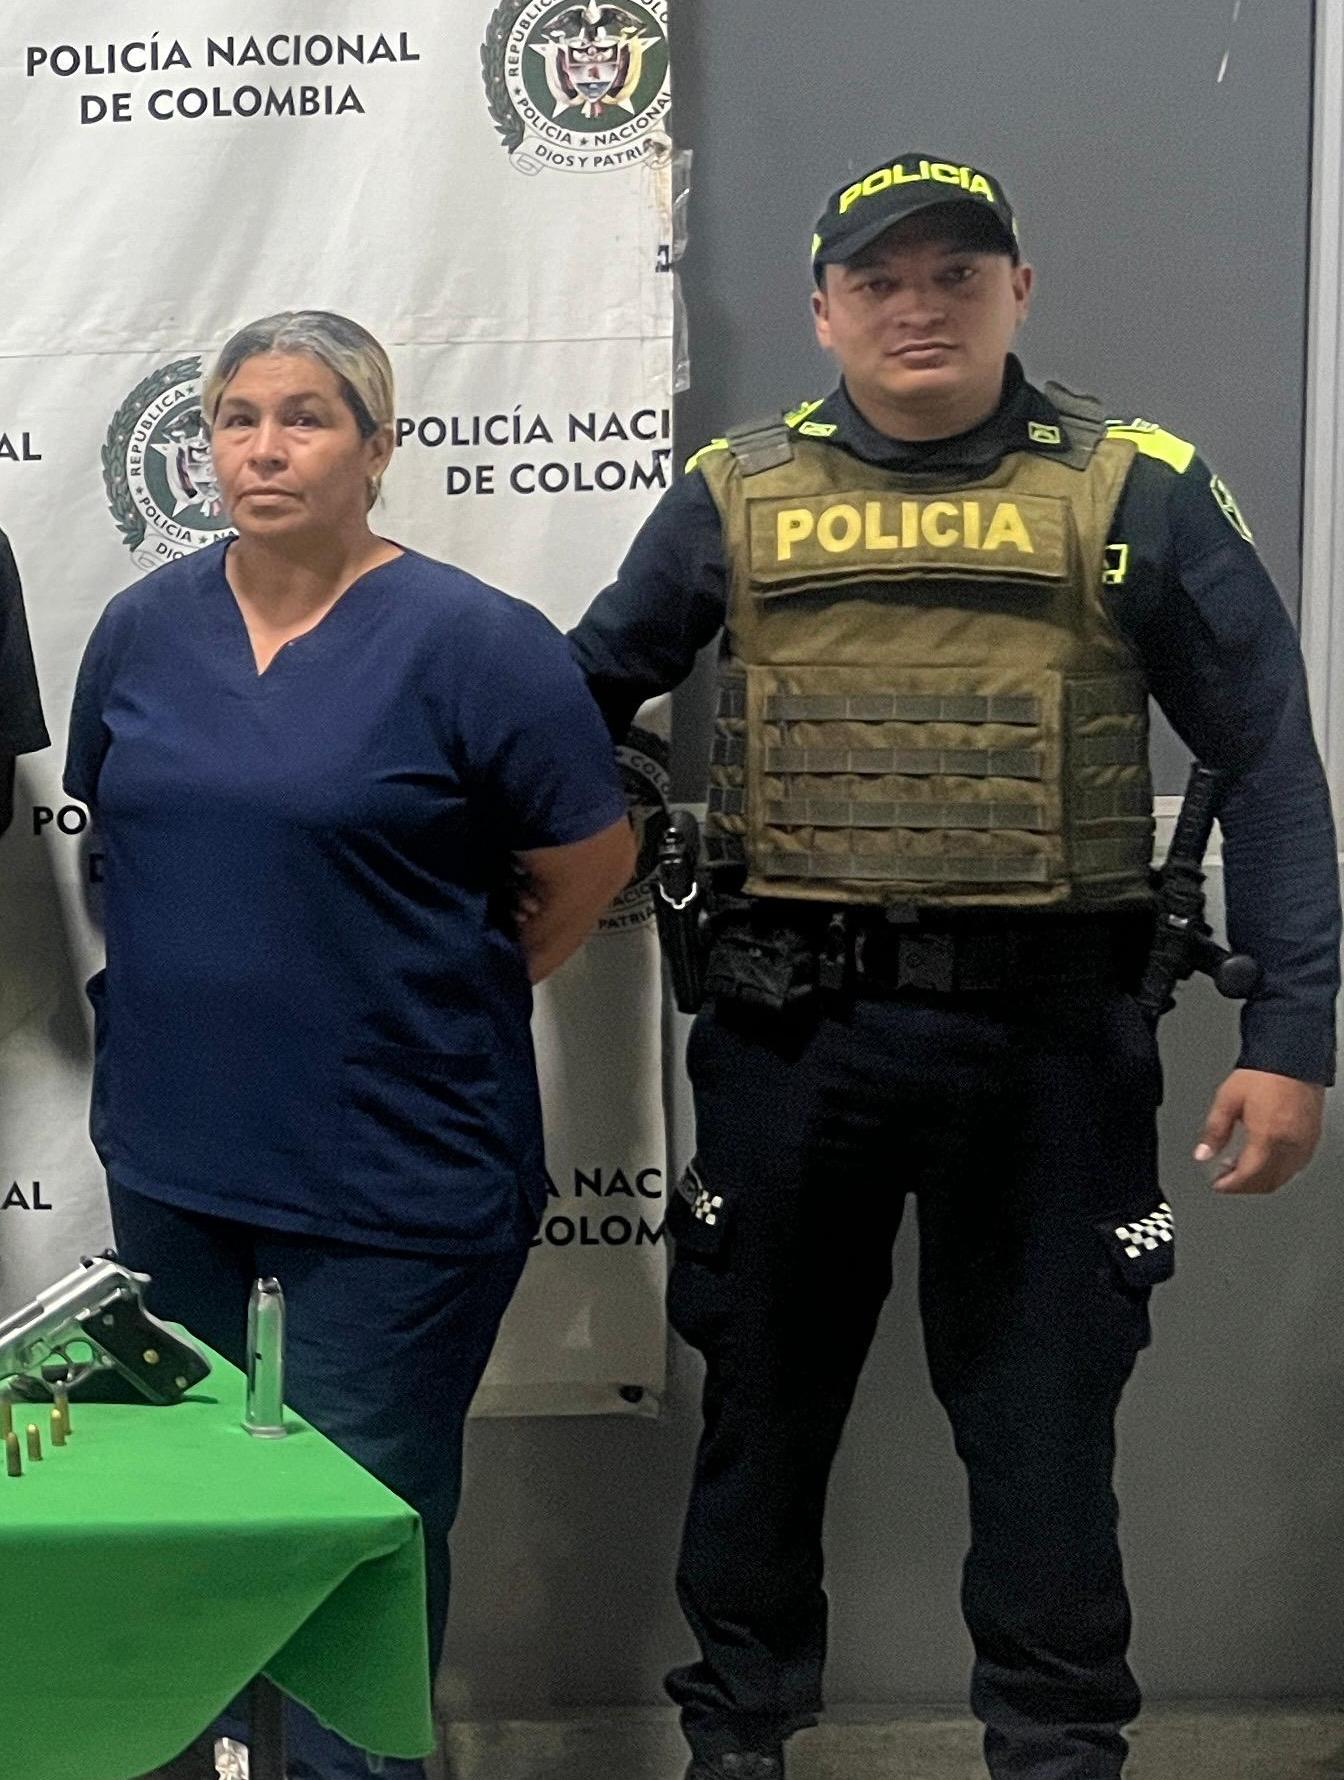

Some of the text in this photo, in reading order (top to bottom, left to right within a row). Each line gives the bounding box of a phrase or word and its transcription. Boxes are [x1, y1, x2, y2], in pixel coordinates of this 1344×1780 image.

[27, 31, 420, 77] POLICÍA NACIONAL
[508, 0, 555, 77] REPUBLIC
[81, 84, 366, 125] DE COLOMBIA
[517, 98, 572, 146] POLICIA
[535, 145, 574, 167] DIOS
[577, 156, 589, 168] Y
[130, 390, 187, 477] REPUBLICA
[396, 404, 554, 447] POLICÍA
[447, 465, 495, 495] DE
[139, 497, 193, 543] POLICIA
[777, 501, 1034, 560] POLICIA
